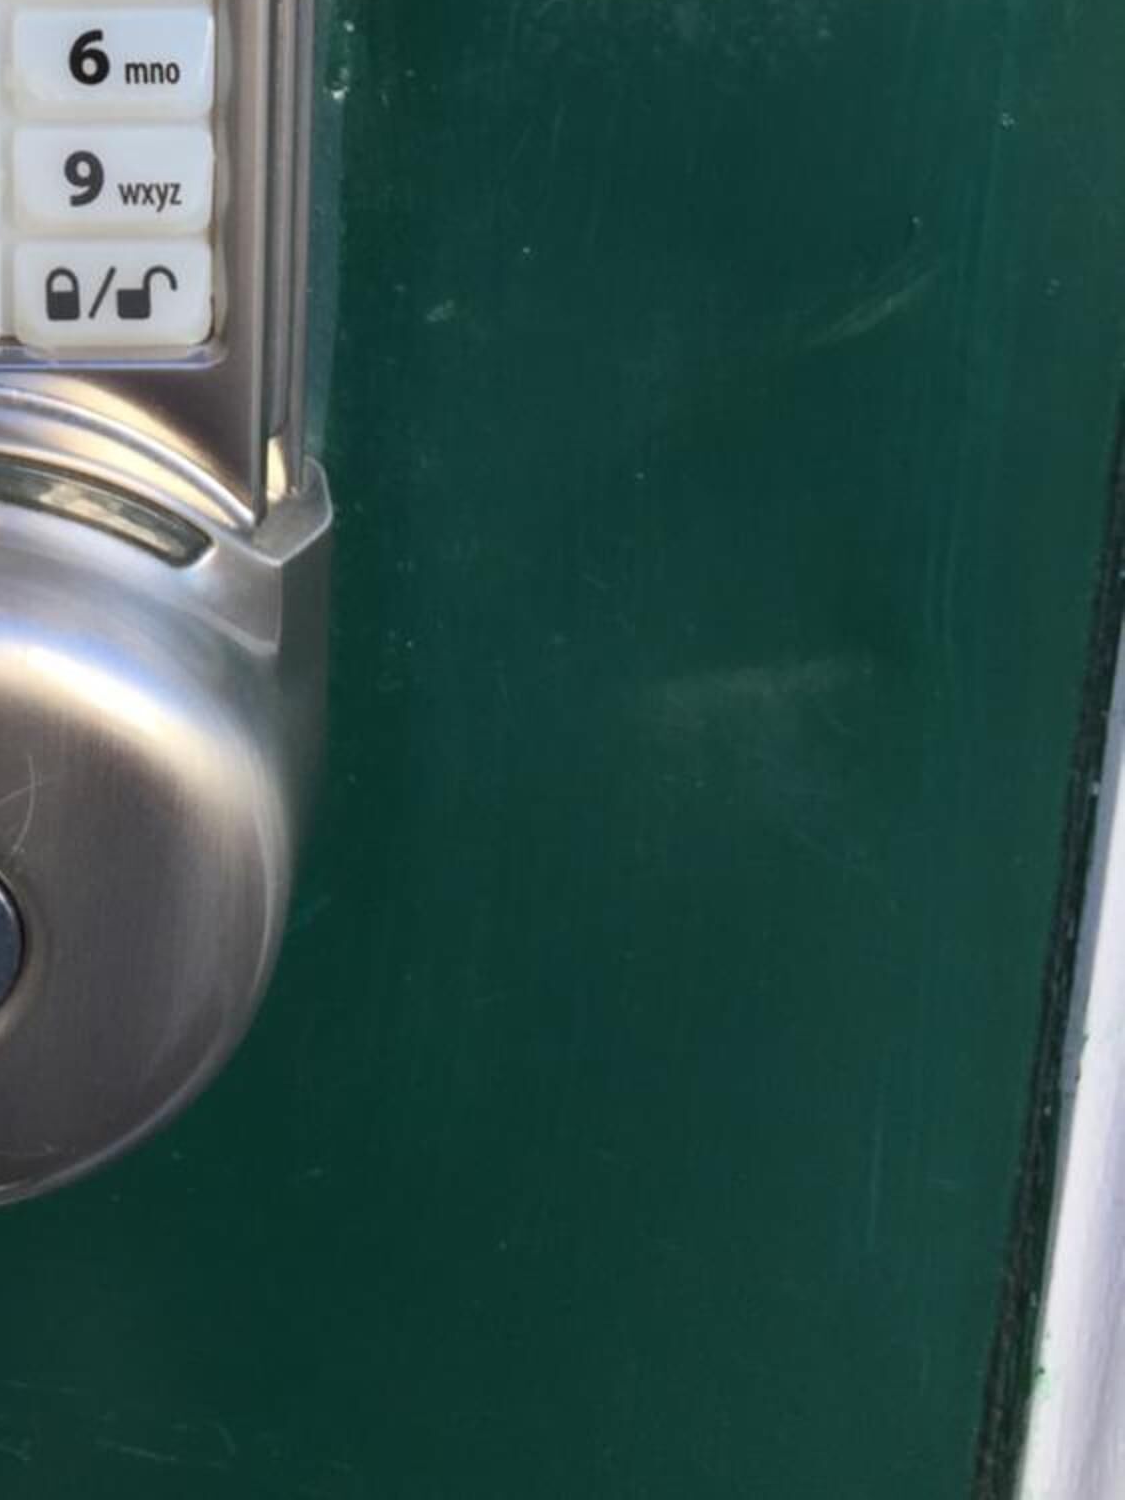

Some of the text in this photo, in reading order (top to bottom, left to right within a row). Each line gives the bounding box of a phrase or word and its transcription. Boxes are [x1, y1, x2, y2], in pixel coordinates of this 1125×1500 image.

[67, 28, 181, 87] 6 mno
[62, 149, 183, 213] 9 wxyz
